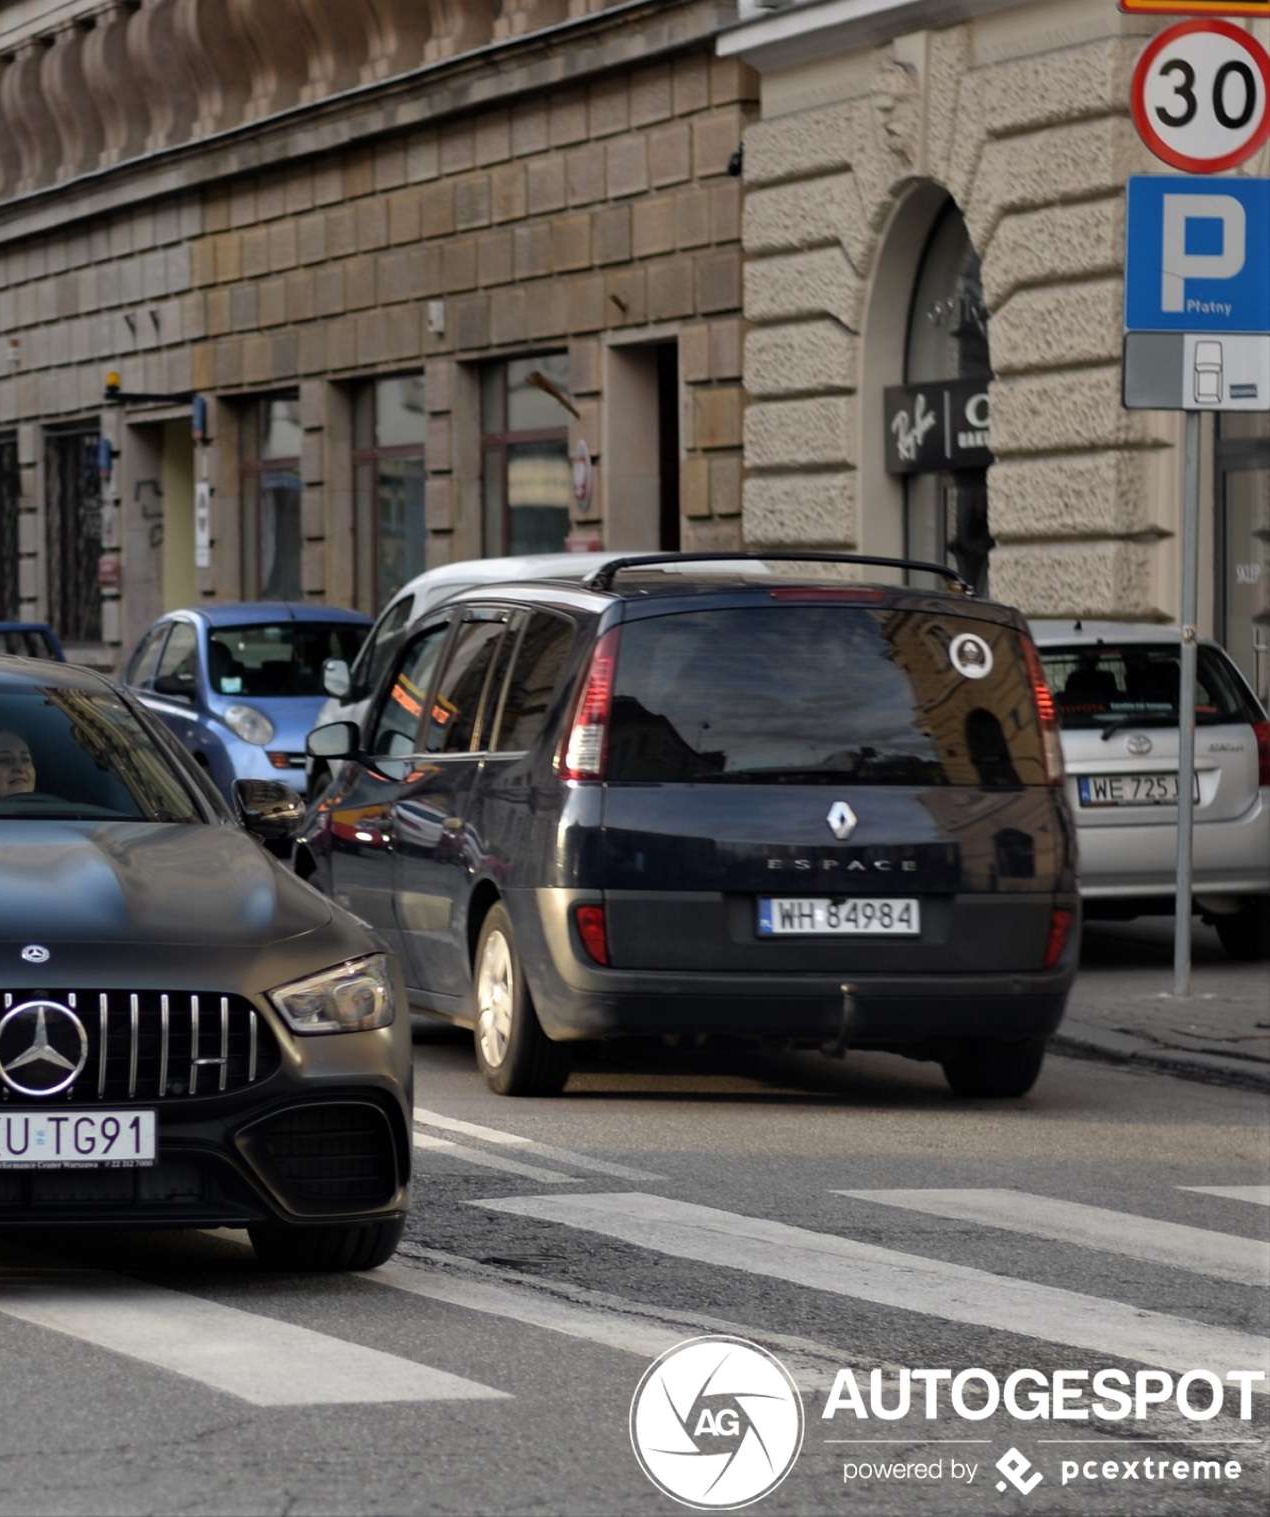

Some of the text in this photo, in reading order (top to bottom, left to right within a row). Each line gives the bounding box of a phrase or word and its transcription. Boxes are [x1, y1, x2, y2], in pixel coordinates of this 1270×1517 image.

[1155, 59, 1256, 129] 30
[1161, 193, 1246, 313] P
[1093, 777, 1123, 800] WE
[767, 858, 918, 872] ESPACE
[778, 902, 913, 929] WH 84984
[47, 1116, 141, 1155] TG91
[37, 1161, 62, 1169] Center
[63, 1160, 98, 1169] Warszawa
